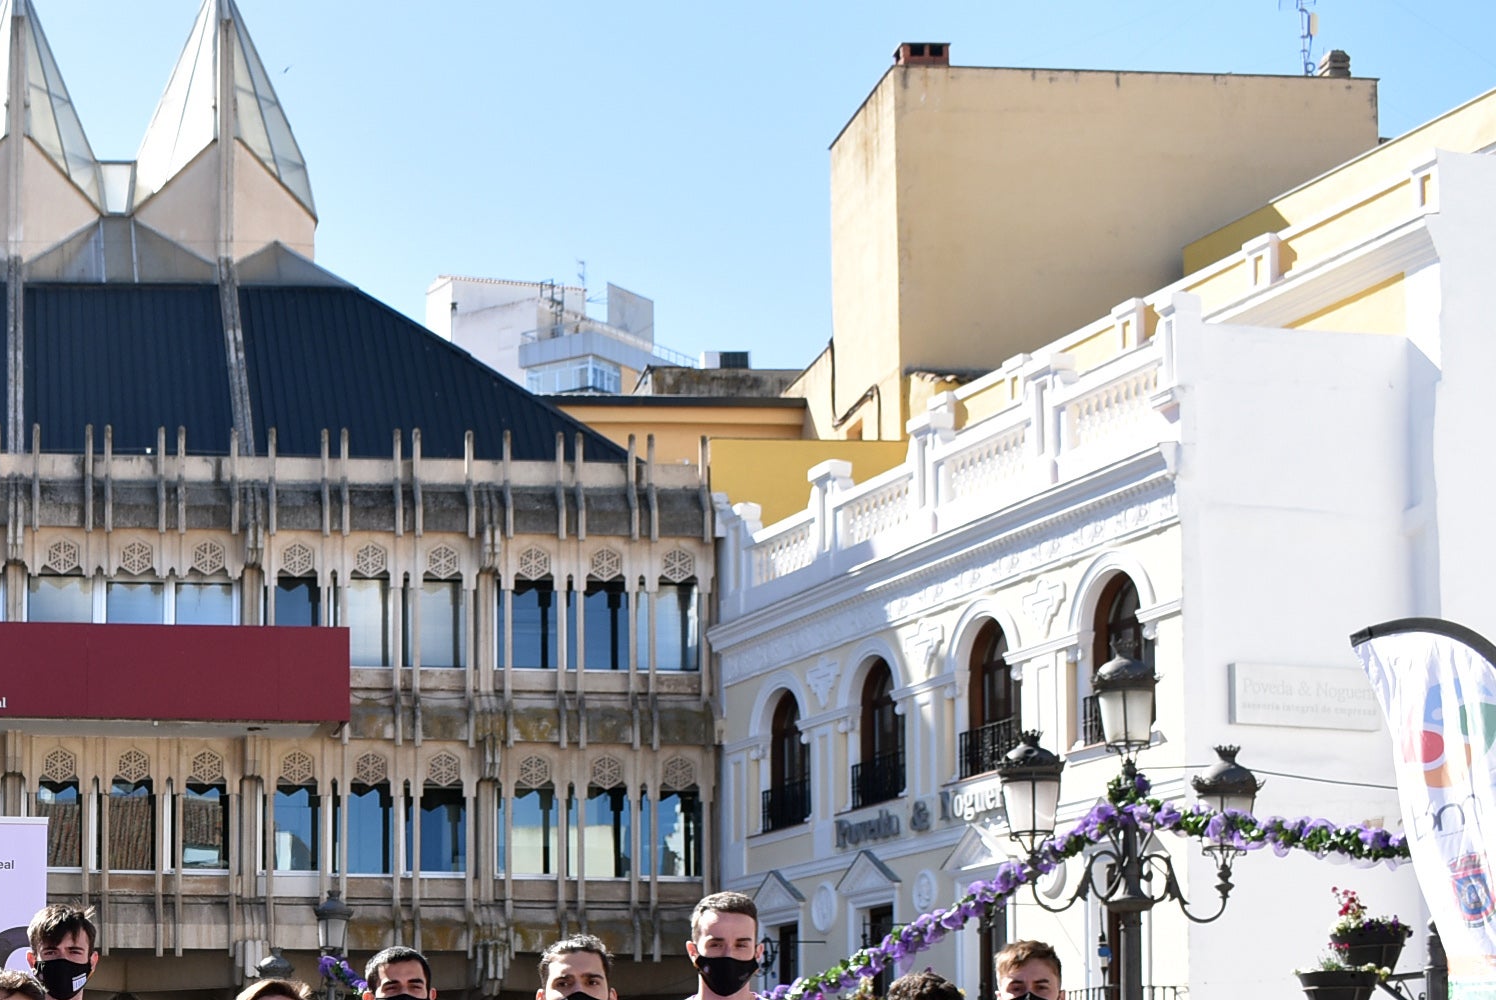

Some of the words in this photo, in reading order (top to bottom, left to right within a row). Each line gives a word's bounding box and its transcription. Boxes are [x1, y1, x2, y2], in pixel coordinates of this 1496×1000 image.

[1242, 678, 1293, 697] Poveda
[1299, 679, 1312, 697] &
[911, 800, 930, 832] &
[939, 787, 1004, 820] Noguer
